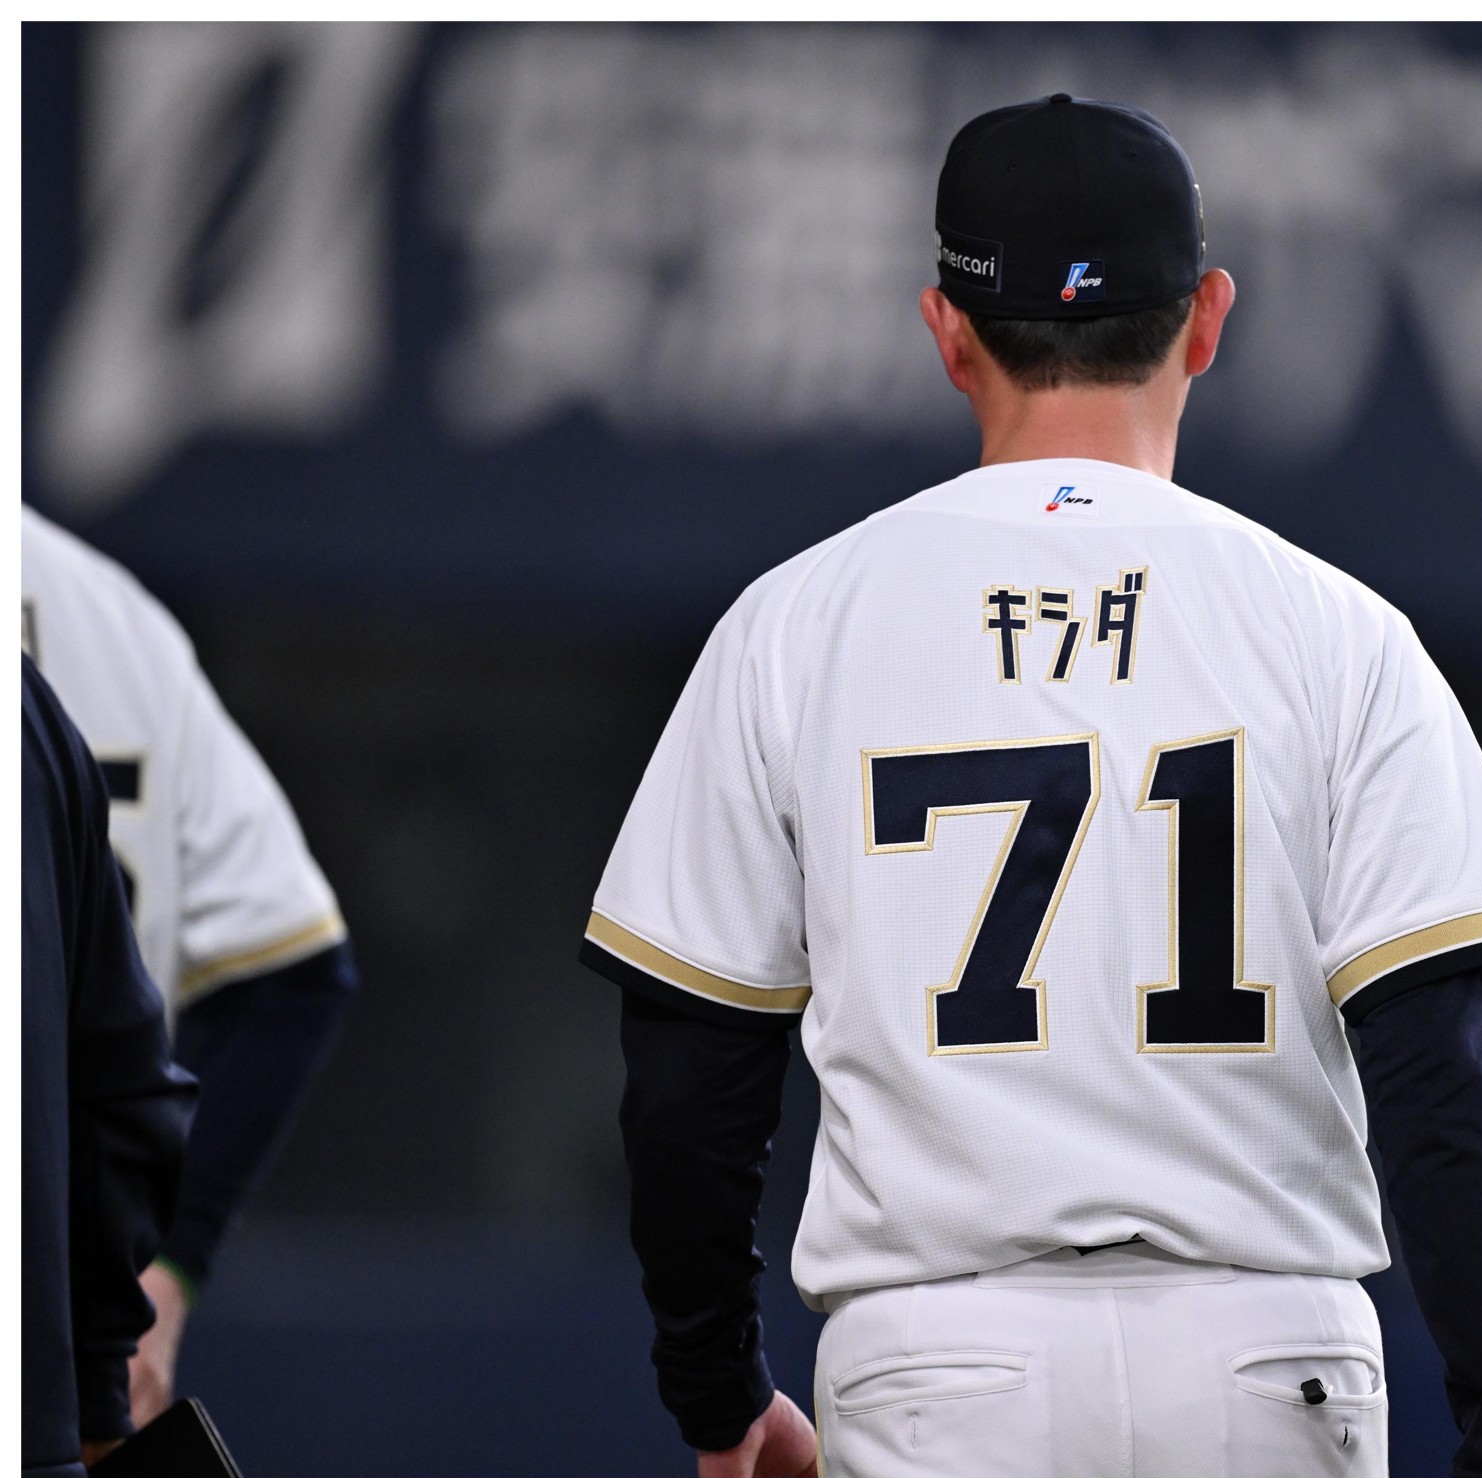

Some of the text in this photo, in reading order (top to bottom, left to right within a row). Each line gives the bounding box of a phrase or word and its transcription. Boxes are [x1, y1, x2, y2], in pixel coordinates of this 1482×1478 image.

[941, 246, 996, 277] mercari
[1077, 276, 1103, 288] NPB
[1063, 496, 1094, 505] NPB
[982, 566, 1149, 685] キシダ
[861, 726, 1276, 1057] 71
